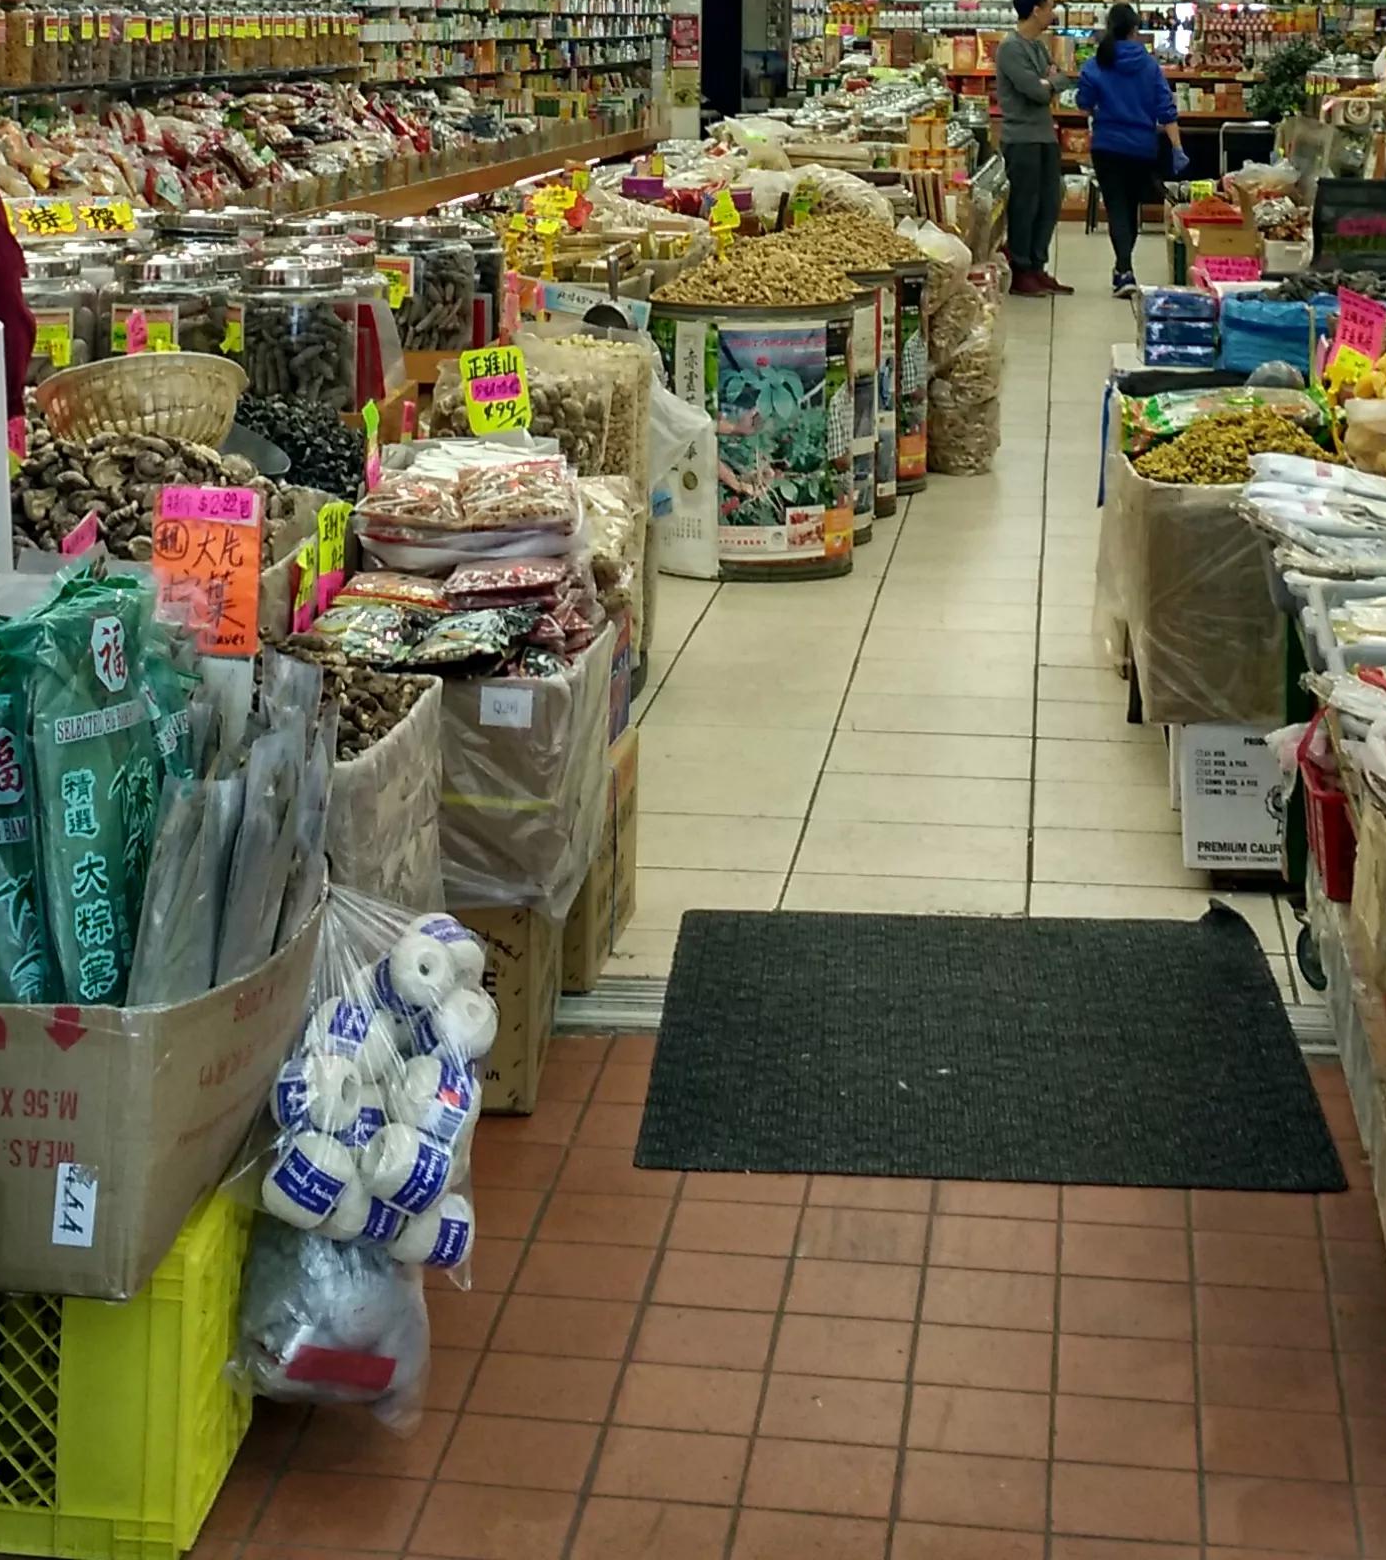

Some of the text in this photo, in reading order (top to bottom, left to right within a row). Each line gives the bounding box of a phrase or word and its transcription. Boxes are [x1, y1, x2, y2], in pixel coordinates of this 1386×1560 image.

[97, 625, 128, 690] 福
[61, 768, 100, 838] 精選
[1197, 841, 1247, 853] PREMIUM
